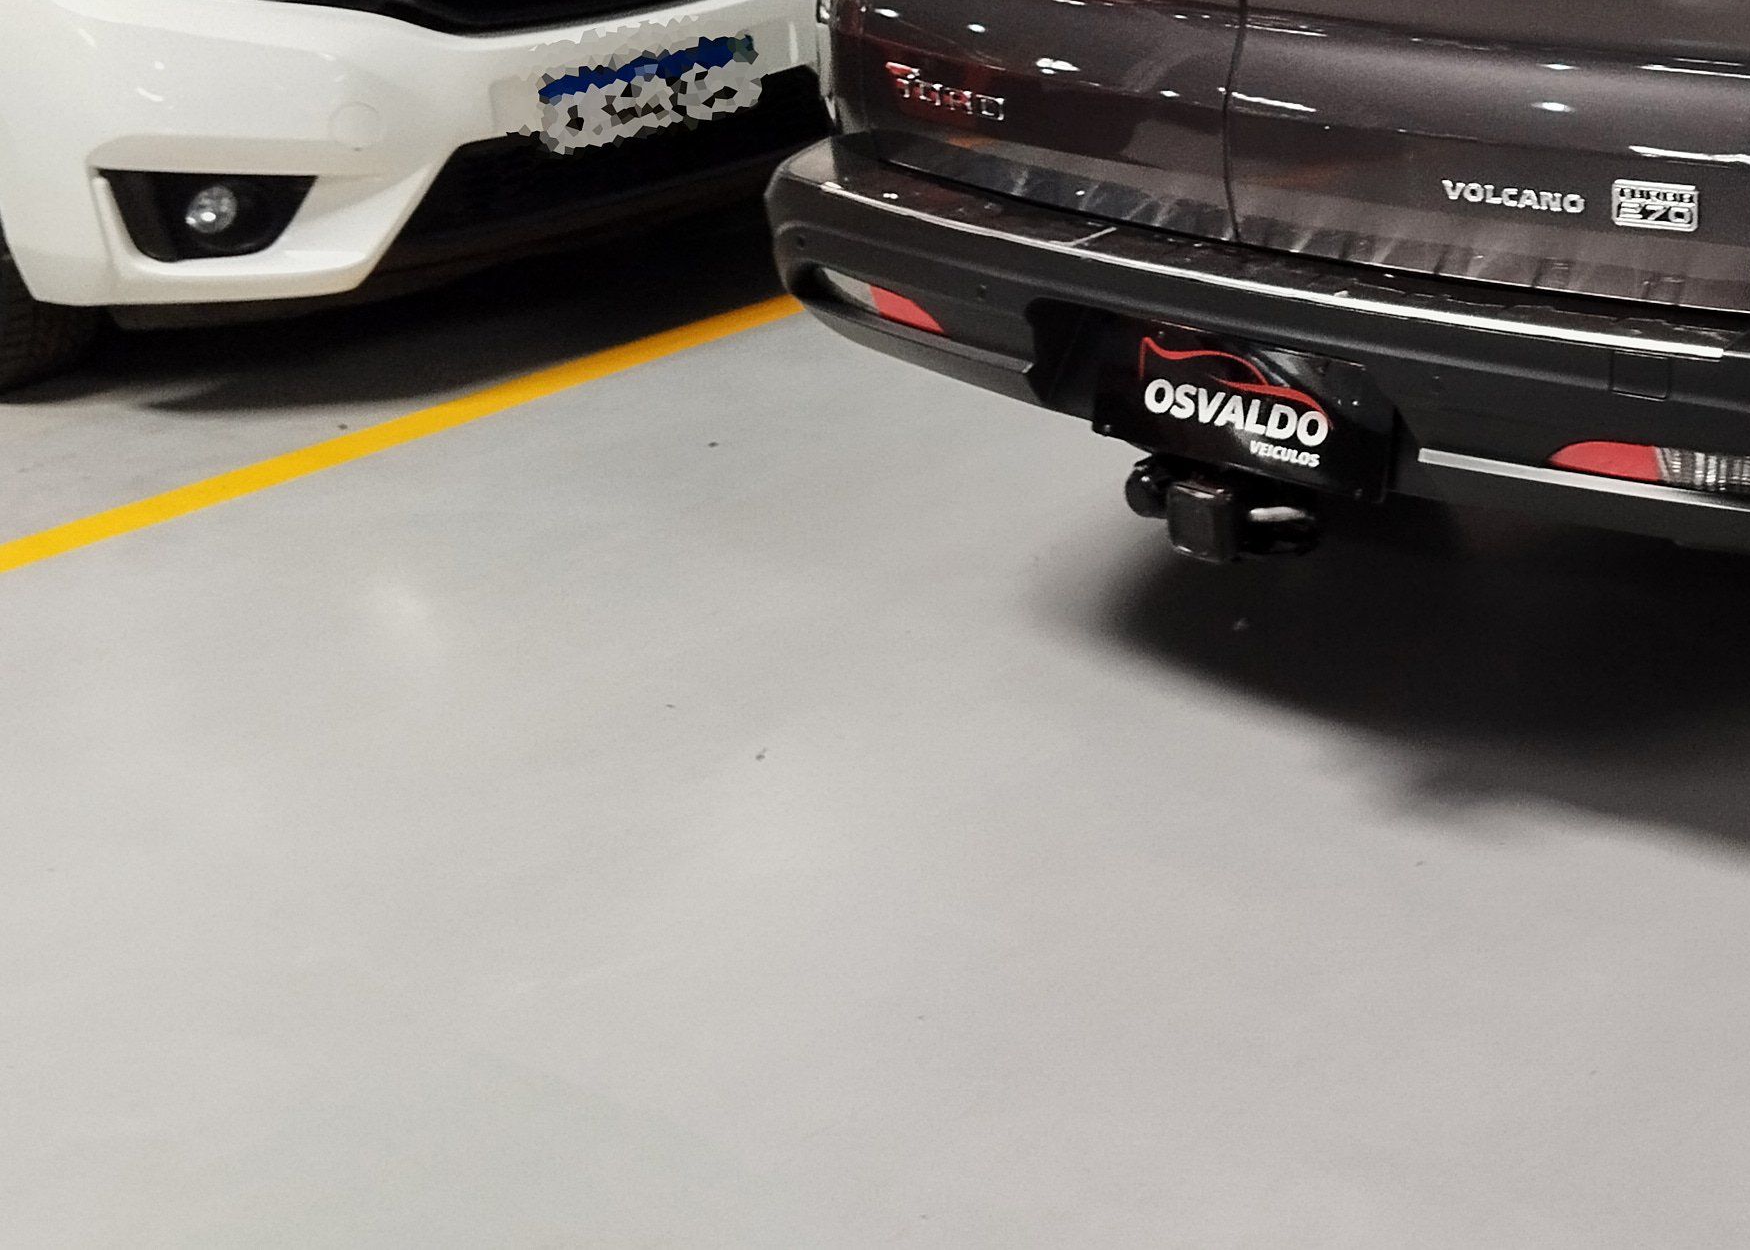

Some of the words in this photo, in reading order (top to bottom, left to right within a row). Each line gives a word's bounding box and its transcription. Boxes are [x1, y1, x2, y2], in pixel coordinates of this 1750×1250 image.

[1441, 179, 1586, 213] VOLCANO
[1144, 378, 1330, 447] OSVALDO
[1248, 439, 1320, 468] VEICULOS
